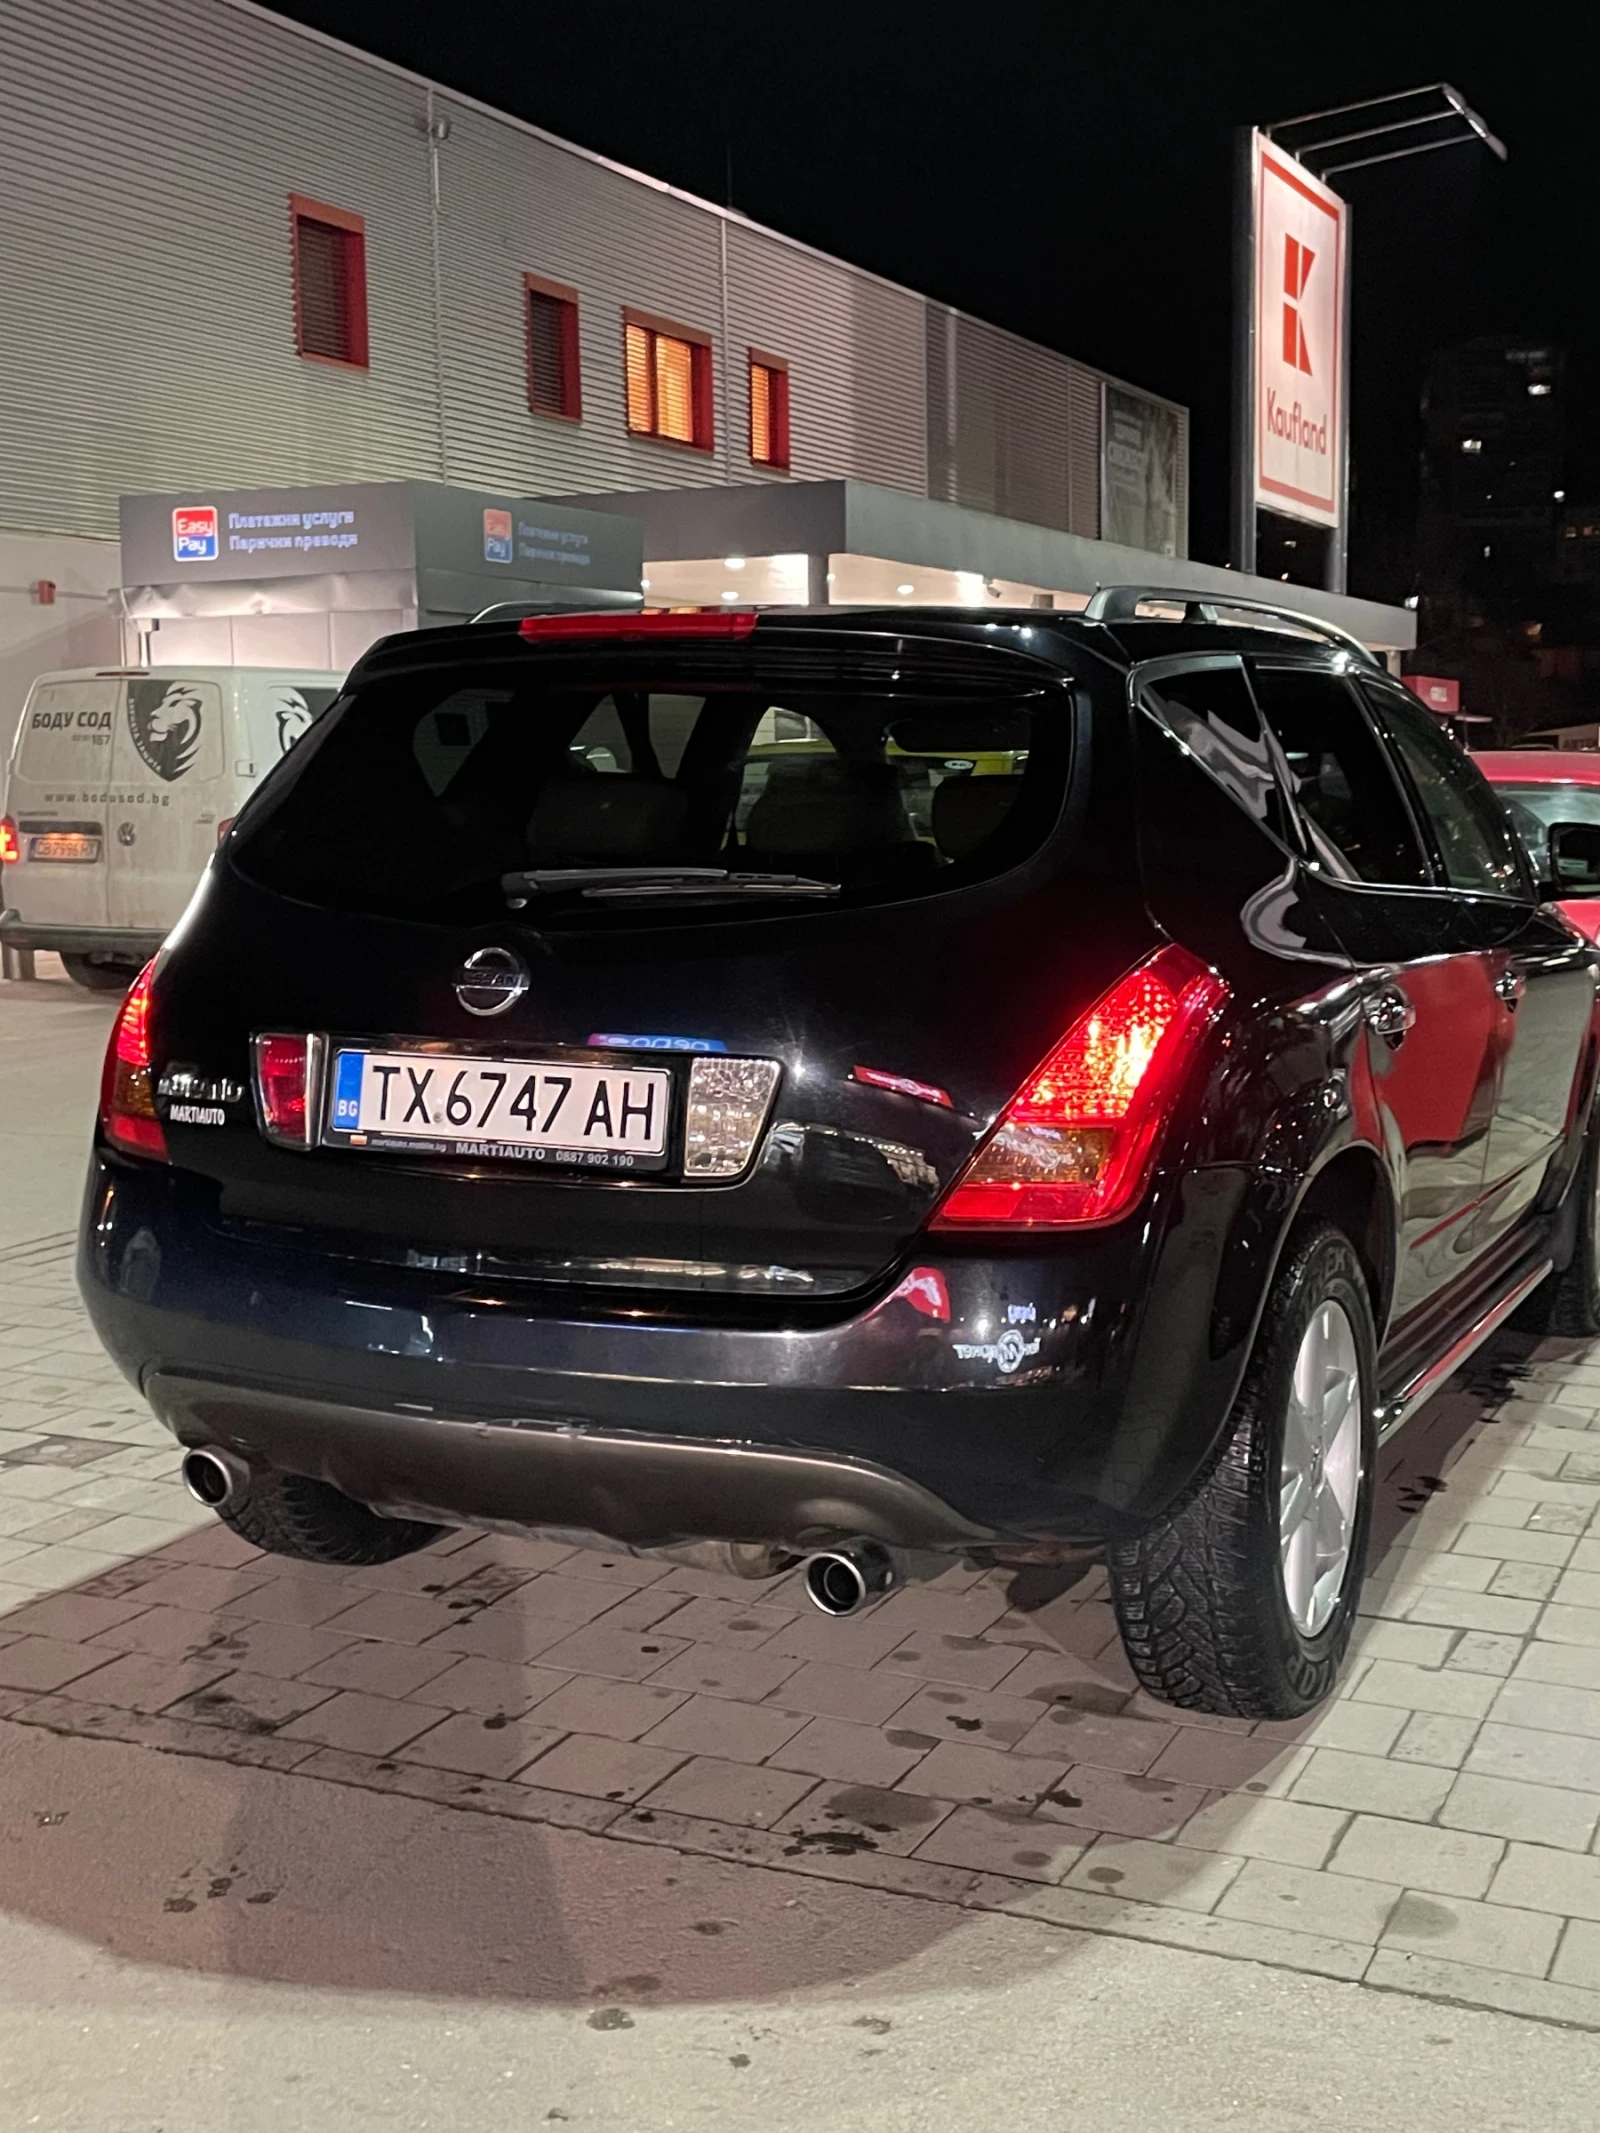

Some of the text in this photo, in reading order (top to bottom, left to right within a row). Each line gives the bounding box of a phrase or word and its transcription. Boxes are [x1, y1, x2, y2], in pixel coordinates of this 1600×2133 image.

[1267, 387, 1327, 455] Kaufland
[177, 518, 213, 537] Easy
[228, 511, 355, 529] Платежни услуги
[178, 537, 207, 555] Pay
[31, 711, 112, 731] БОДУ СОД
[44, 792, 170, 807] www.bodusod.bg
[337, 1099, 359, 1118] BG
[372, 1065, 656, 1141] TX 6747 AH
[170, 1104, 225, 1126] MARTIAUTO
[455, 1141, 546, 1161] MARTIAUTO
[555, 1150, 584, 1163] 0887
[586, 1152, 610, 1165] 902
[612, 1154, 635, 1167] 190
